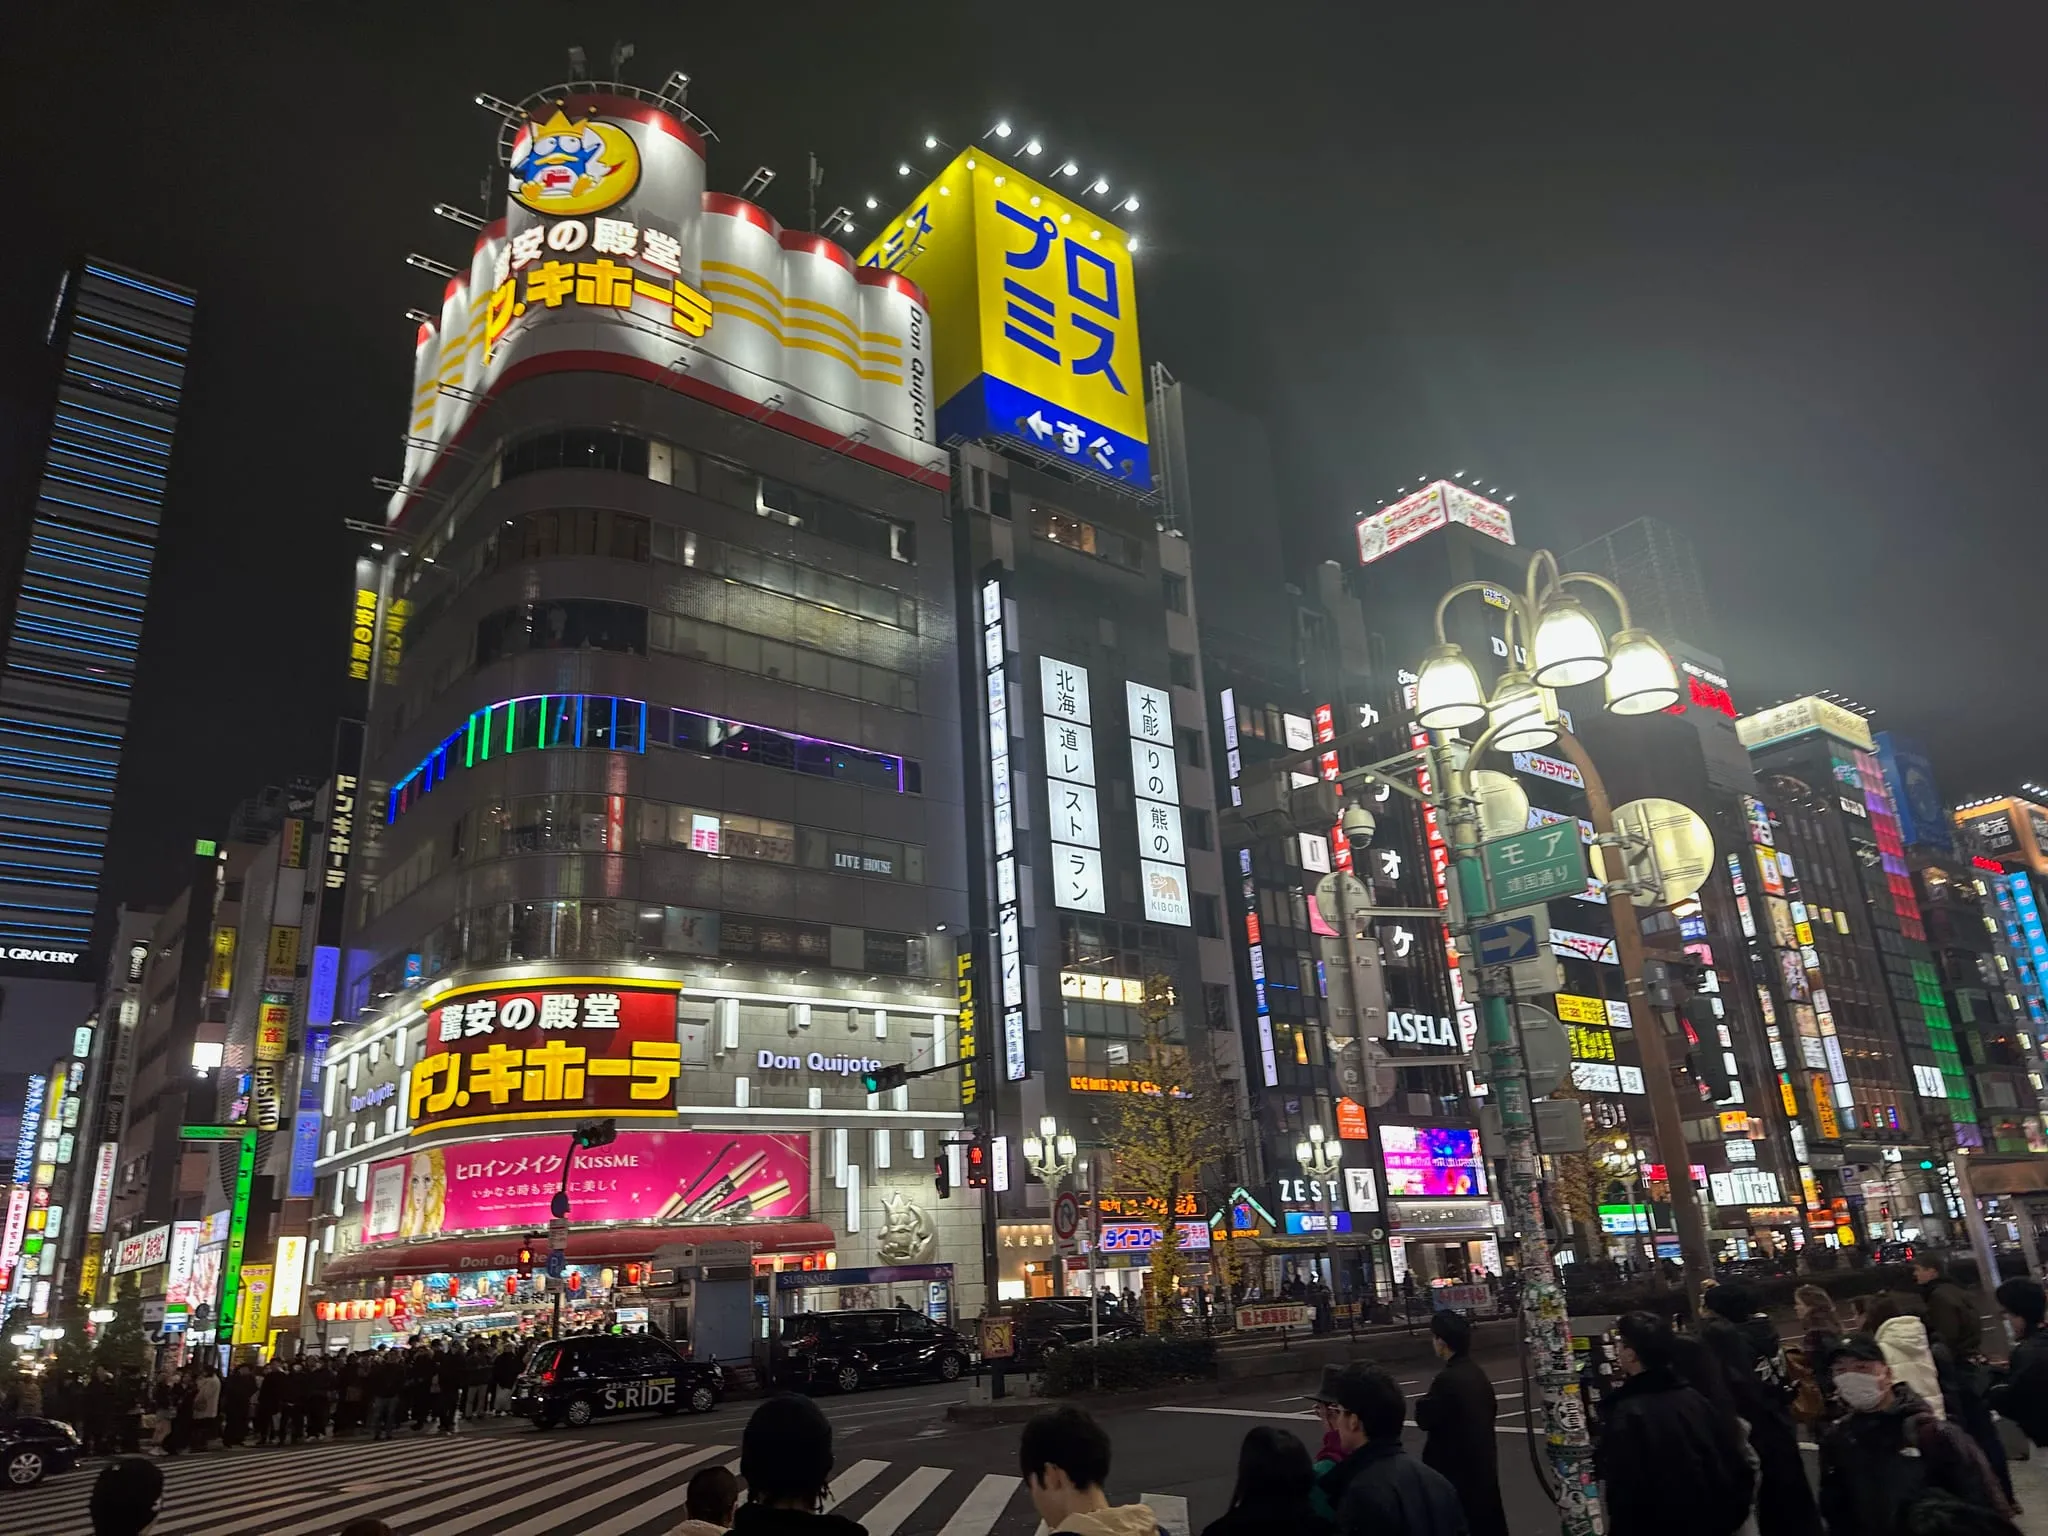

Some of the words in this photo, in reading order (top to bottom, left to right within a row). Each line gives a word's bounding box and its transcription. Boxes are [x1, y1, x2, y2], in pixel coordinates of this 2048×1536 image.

[908, 305, 924, 351] Don
[1140, 693, 1170, 855] 木彫りの熊の
[1536, 759, 1573, 780] カラオケ
[1055, 669, 1089, 902] 北海道レストラン
[1501, 831, 1564, 865] モア
[1507, 865, 1569, 893] 靖国通り
[1151, 900, 1184, 915] KIBORI
[8, 947, 79, 964] GRACERY
[439, 993, 621, 1042] 驚安の殿堂
[757, 1049, 801, 1069] Don
[807, 1052, 882, 1076] Quijote
[256, 1066, 279, 1127] CASINO
[455, 1154, 562, 1182] ヒロインメイク
[1278, 1179, 1339, 1202] ZEST
[493, 1252, 548, 1268] Quite
